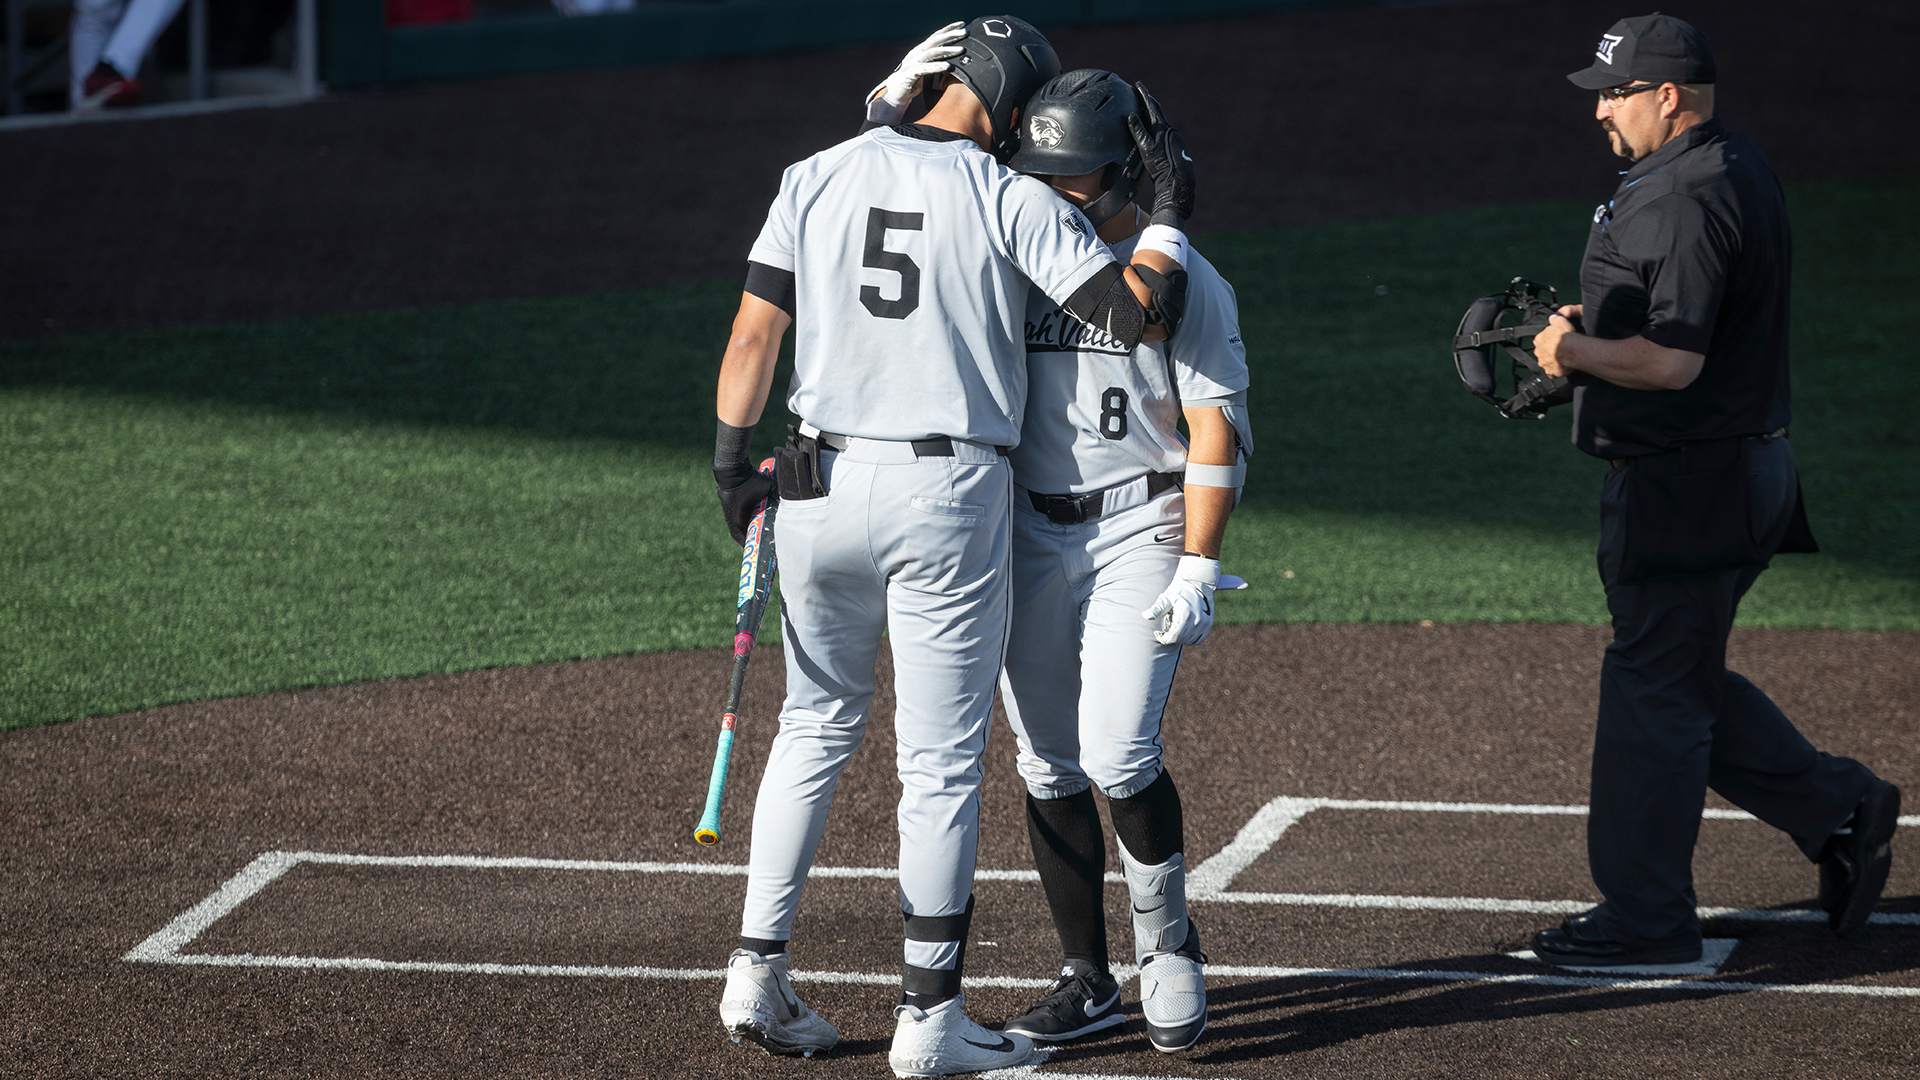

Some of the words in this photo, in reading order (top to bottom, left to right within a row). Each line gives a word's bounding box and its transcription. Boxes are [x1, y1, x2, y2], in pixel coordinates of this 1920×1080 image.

[859, 206, 924, 320] 5
[1025, 313, 1054, 343] ah
[1100, 387, 1129, 441] 8
